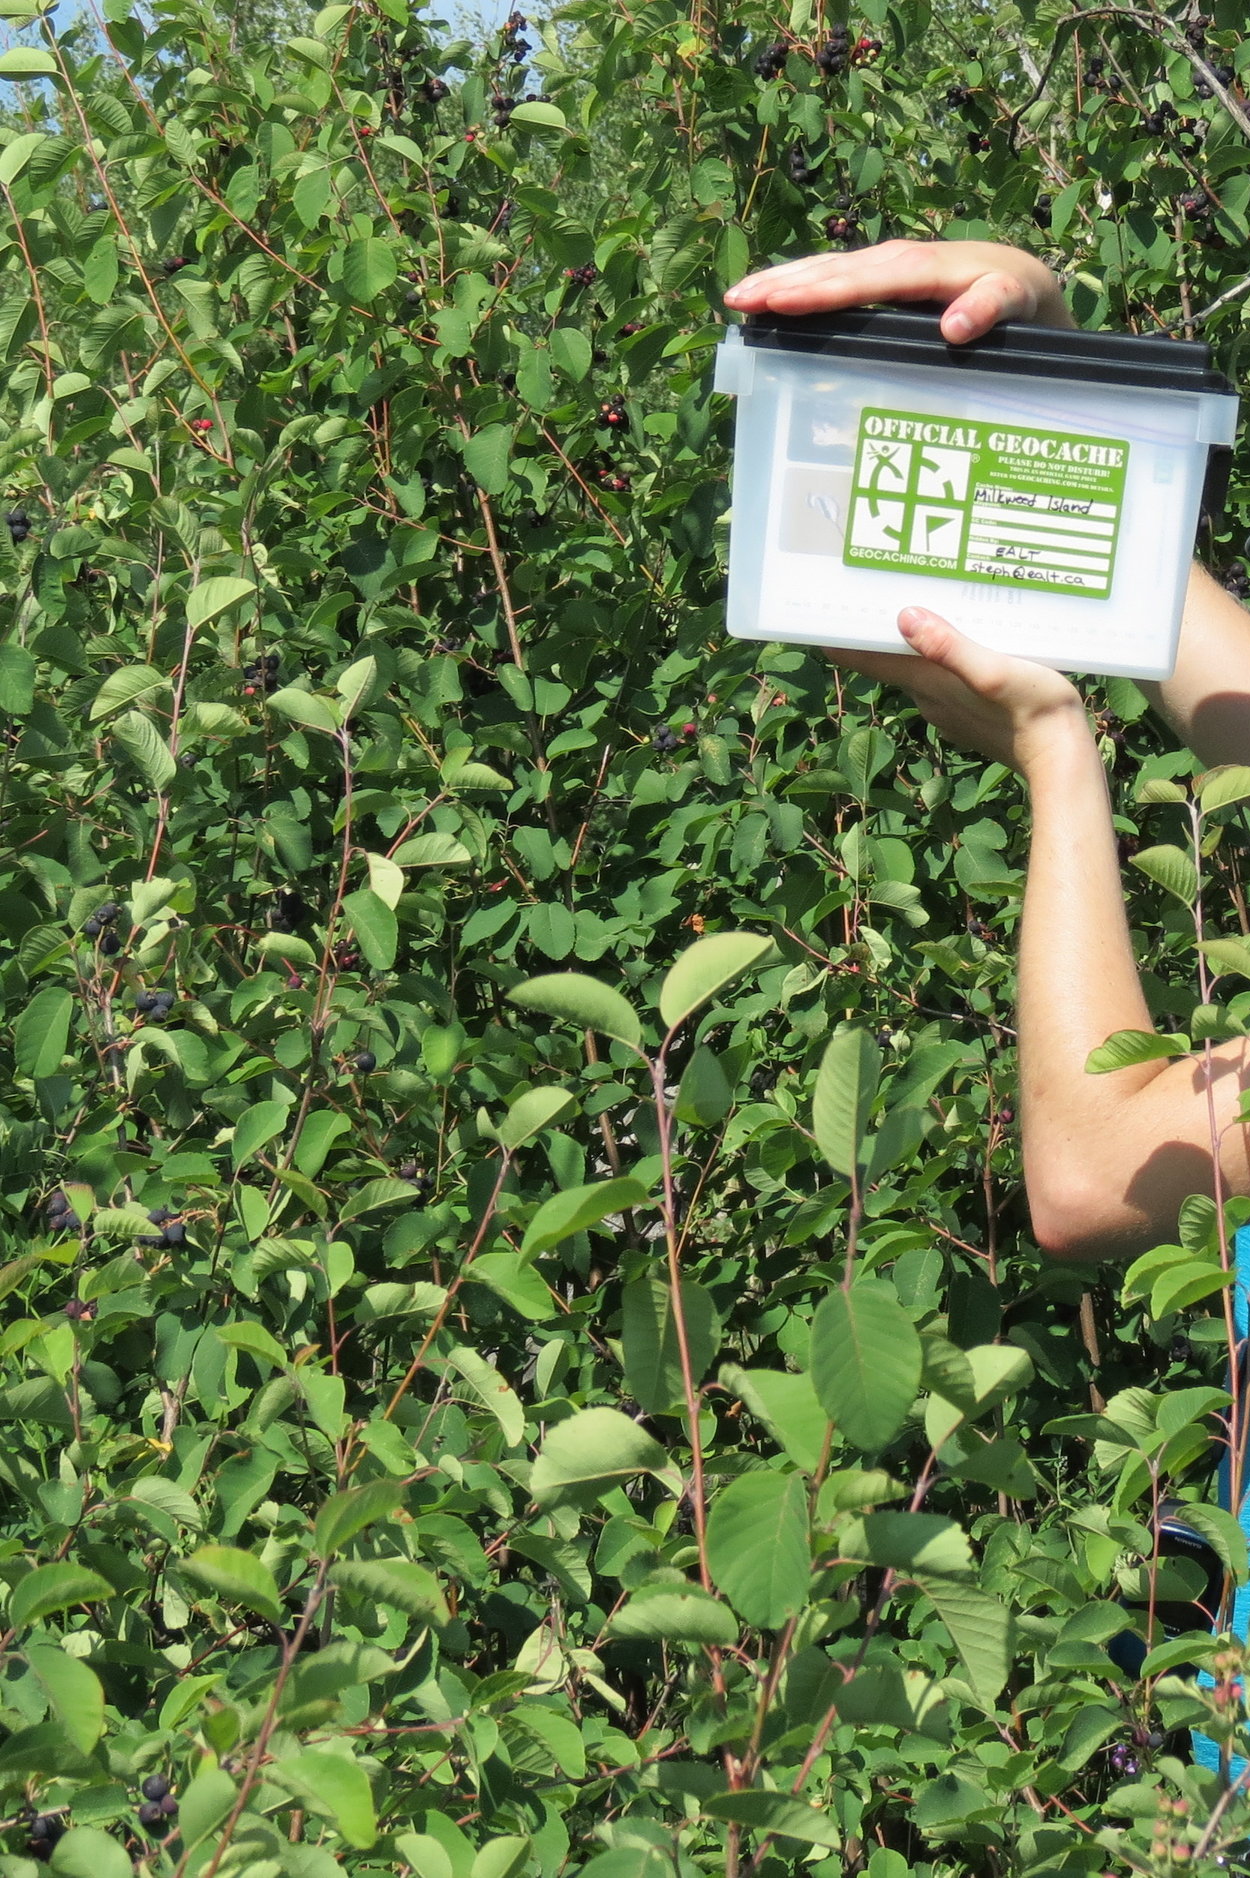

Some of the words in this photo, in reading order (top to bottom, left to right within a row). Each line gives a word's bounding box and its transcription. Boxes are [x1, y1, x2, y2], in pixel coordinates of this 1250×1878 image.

[865, 416, 982, 449] OFFICIAL
[988, 432, 1123, 467] GEOCACHE
[998, 456, 1032, 467] PLEASE
[1033, 460, 1046, 469] DO
[1047, 462, 1066, 471] NOT
[1067, 465, 1110, 477] DISTURB!
[1017, 474, 1076, 487] GEOCACHING.COM
[1048, 496, 1093, 515] Island
[849, 547, 957, 570] GEOCACHING.COM
[996, 546, 1041, 561] EALT
[971, 562, 1085, 585] steph@ealt.ca
